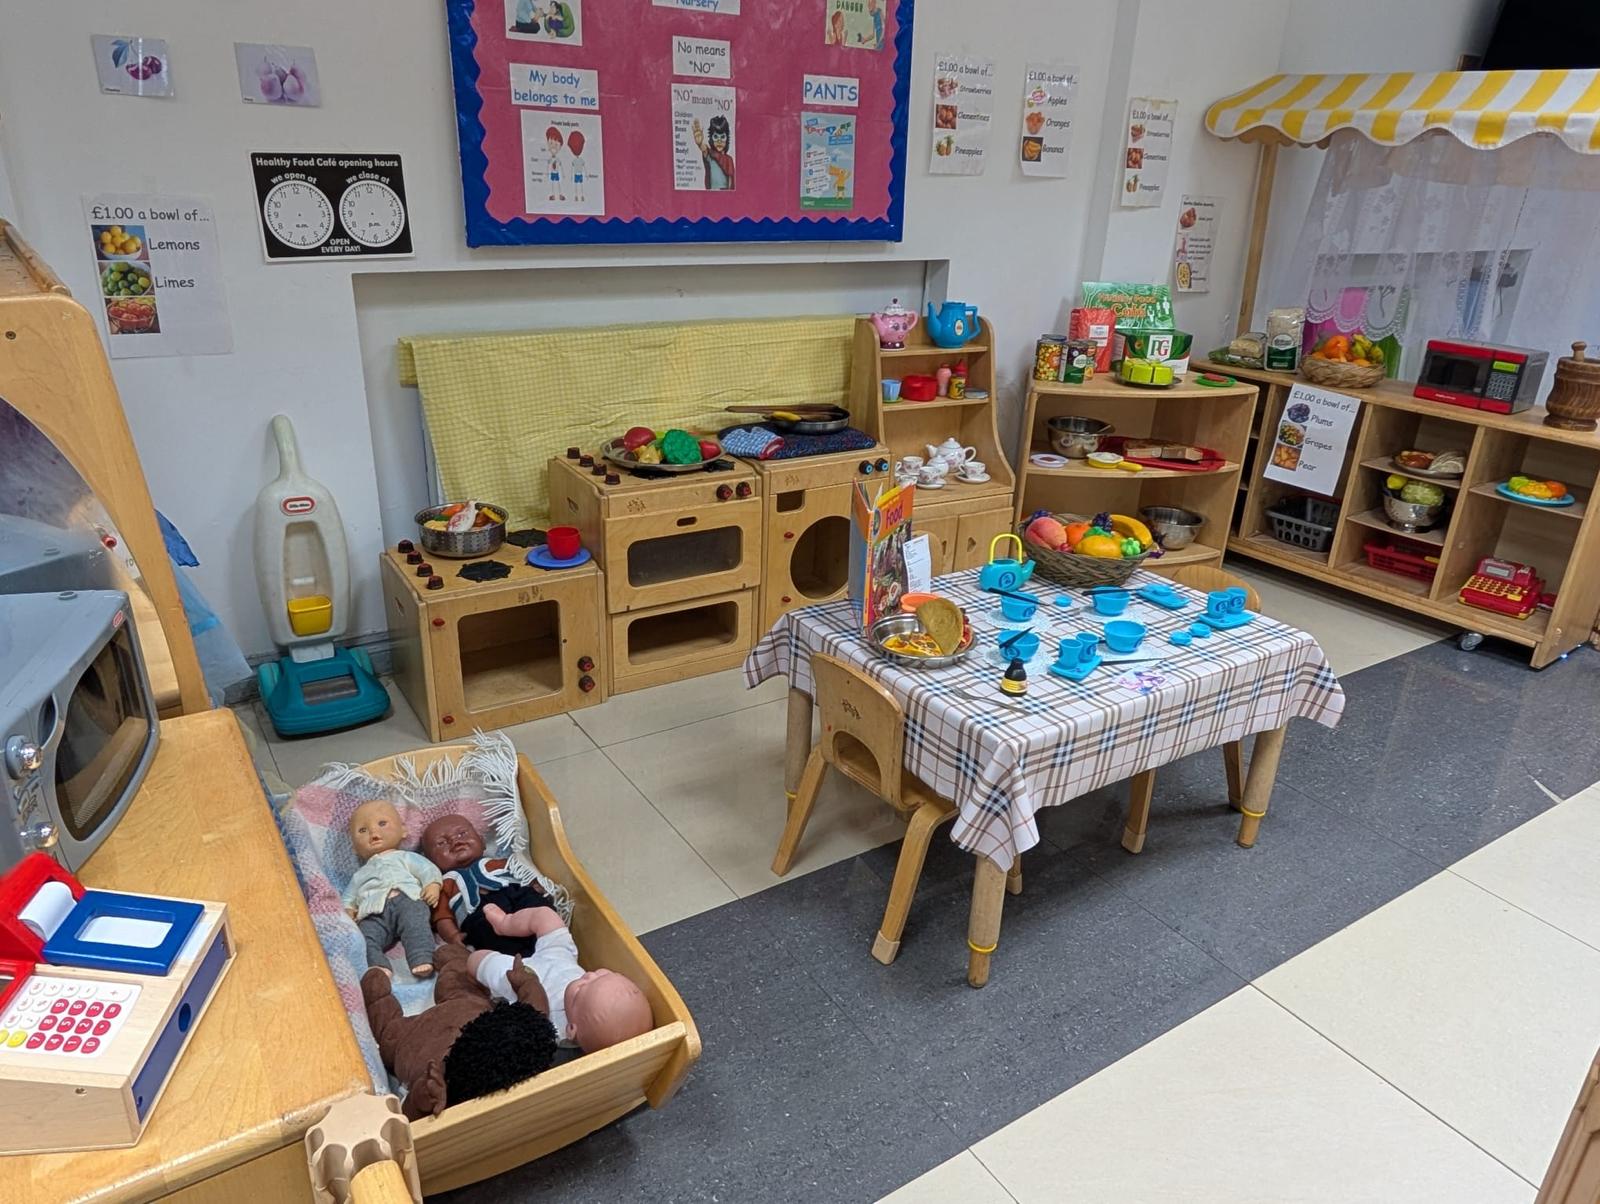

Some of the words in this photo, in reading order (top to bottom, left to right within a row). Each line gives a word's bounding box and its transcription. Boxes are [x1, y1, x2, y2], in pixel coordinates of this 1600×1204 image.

[678, 41, 692, 53] No
[695, 46, 726, 57] means
[529, 70, 547, 86] My
[552, 72, 580, 88] body
[514, 89, 558, 106] belongs
[563, 94, 576, 105] to
[580, 97, 596, 106] me
[804, 81, 858, 101] PANTS
[1048, 96, 1067, 106] Apples
[1046, 119, 1071, 130] Oranges
[1043, 144, 1064, 154] Bananas
[256, 157, 291, 168] Healthy
[293, 158, 315, 167] Food
[316, 158, 337, 167] Café
[338, 158, 373, 169] opening
[374, 158, 399, 167] hours
[270, 175, 283, 184] we
[285, 172, 306, 180] open
[308, 175, 317, 185] at
[346, 176, 358, 184] we
[358, 171, 379, 180] close
[380, 176, 390, 185] at
[292, 187, 300, 195] 12
[274, 201, 282, 209] 10
[348, 200, 355, 208] 10
[91, 206, 134, 220] £1.00
[138, 211, 147, 220] a
[150, 208, 180, 221] bowl
[149, 238, 201, 251] Lemons
[321, 246, 343, 254] EVERY
[155, 277, 195, 289] Limes
[1151, 339, 1170, 356] PG
[1293, 391, 1316, 404] £1.00
[1322, 397, 1340, 410] bowl
[1310, 414, 1333, 428] Plums
[1304, 437, 1333, 451] Grapes
[1298, 461, 1317, 471] Pear
